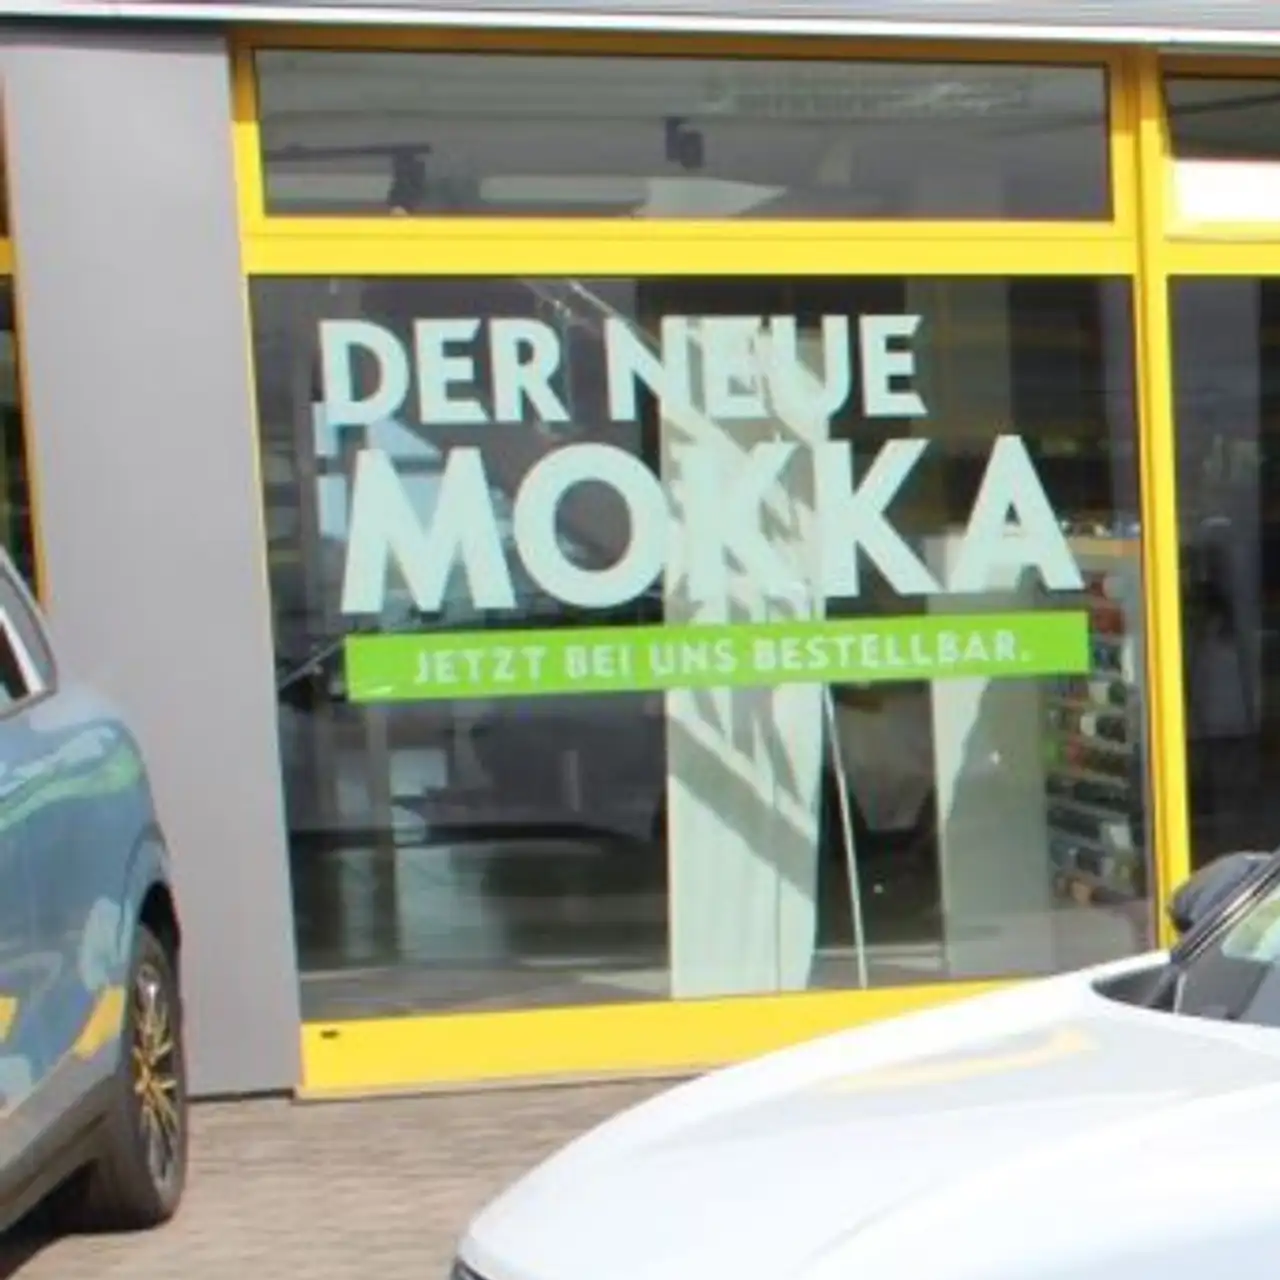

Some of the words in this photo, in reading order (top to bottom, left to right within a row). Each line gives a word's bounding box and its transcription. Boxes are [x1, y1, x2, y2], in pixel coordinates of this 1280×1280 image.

[318, 318, 571, 425] DER
[604, 315, 927, 422] NEUE
[341, 434, 1084, 614] MOKKA
[414, 645, 546, 685] JETZT
[566, 644, 631, 680] BEI
[650, 640, 737, 677] UNS
[753, 632, 1031, 671] BESTELLBAR.
